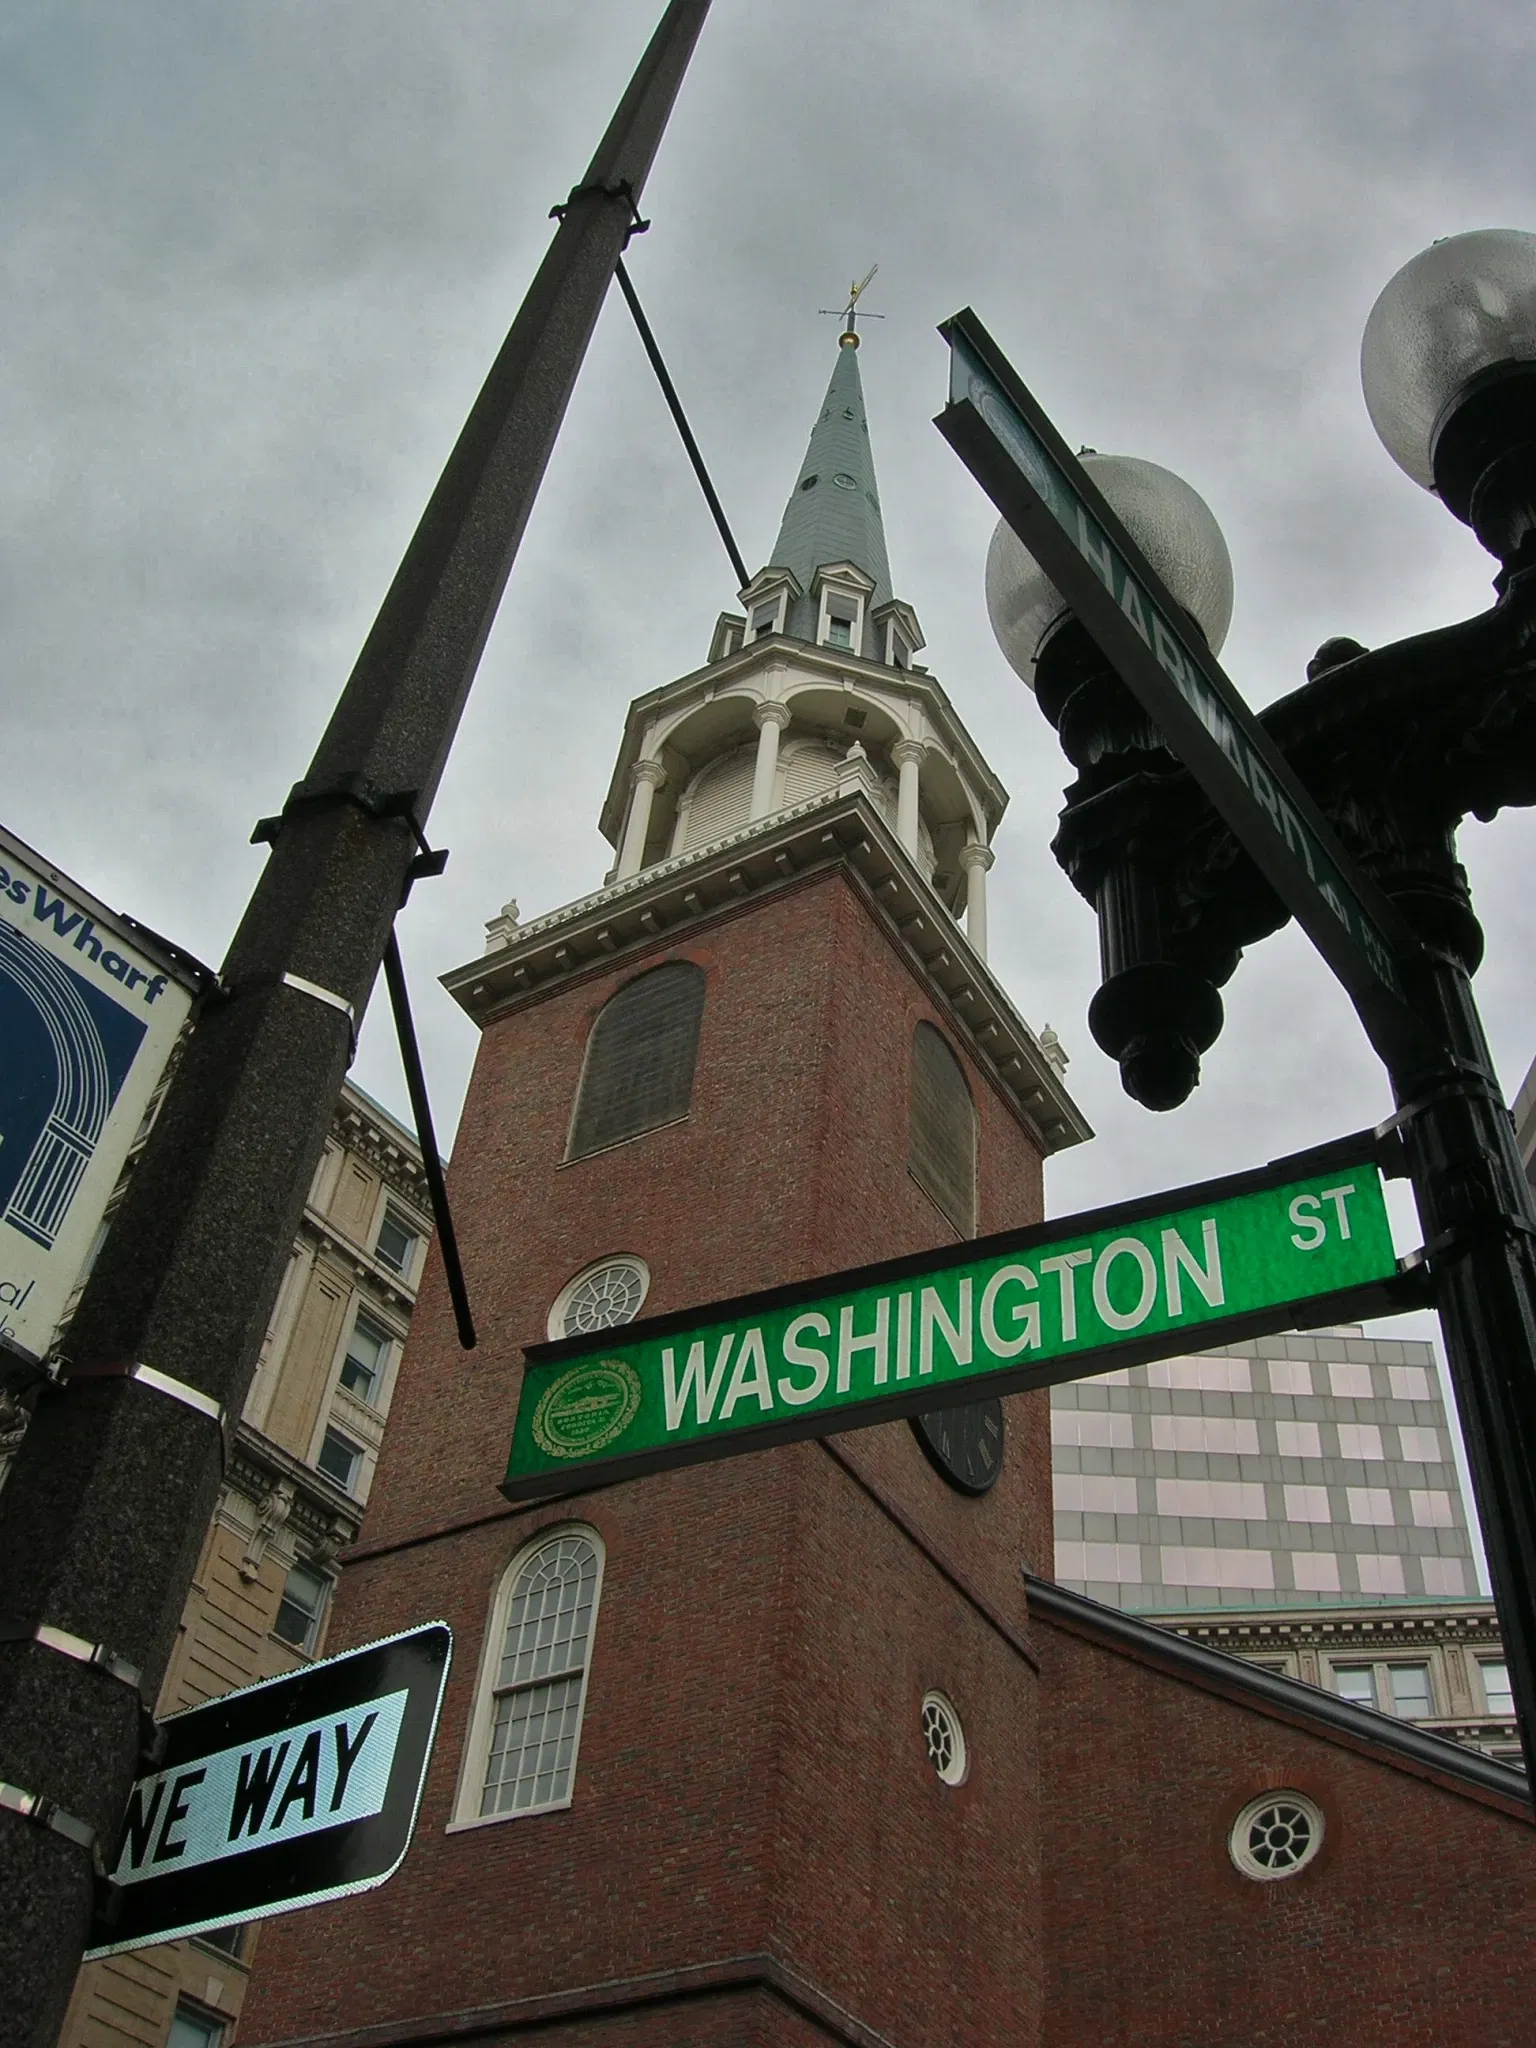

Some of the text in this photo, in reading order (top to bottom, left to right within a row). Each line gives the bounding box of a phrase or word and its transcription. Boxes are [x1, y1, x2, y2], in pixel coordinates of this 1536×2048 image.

[1076, 505, 1316, 883] HARVARD
[33, 884, 169, 1005] Wharf
[661, 1184, 1356, 1431] WASHINGTON ST
[227, 1711, 380, 1843] WAY
